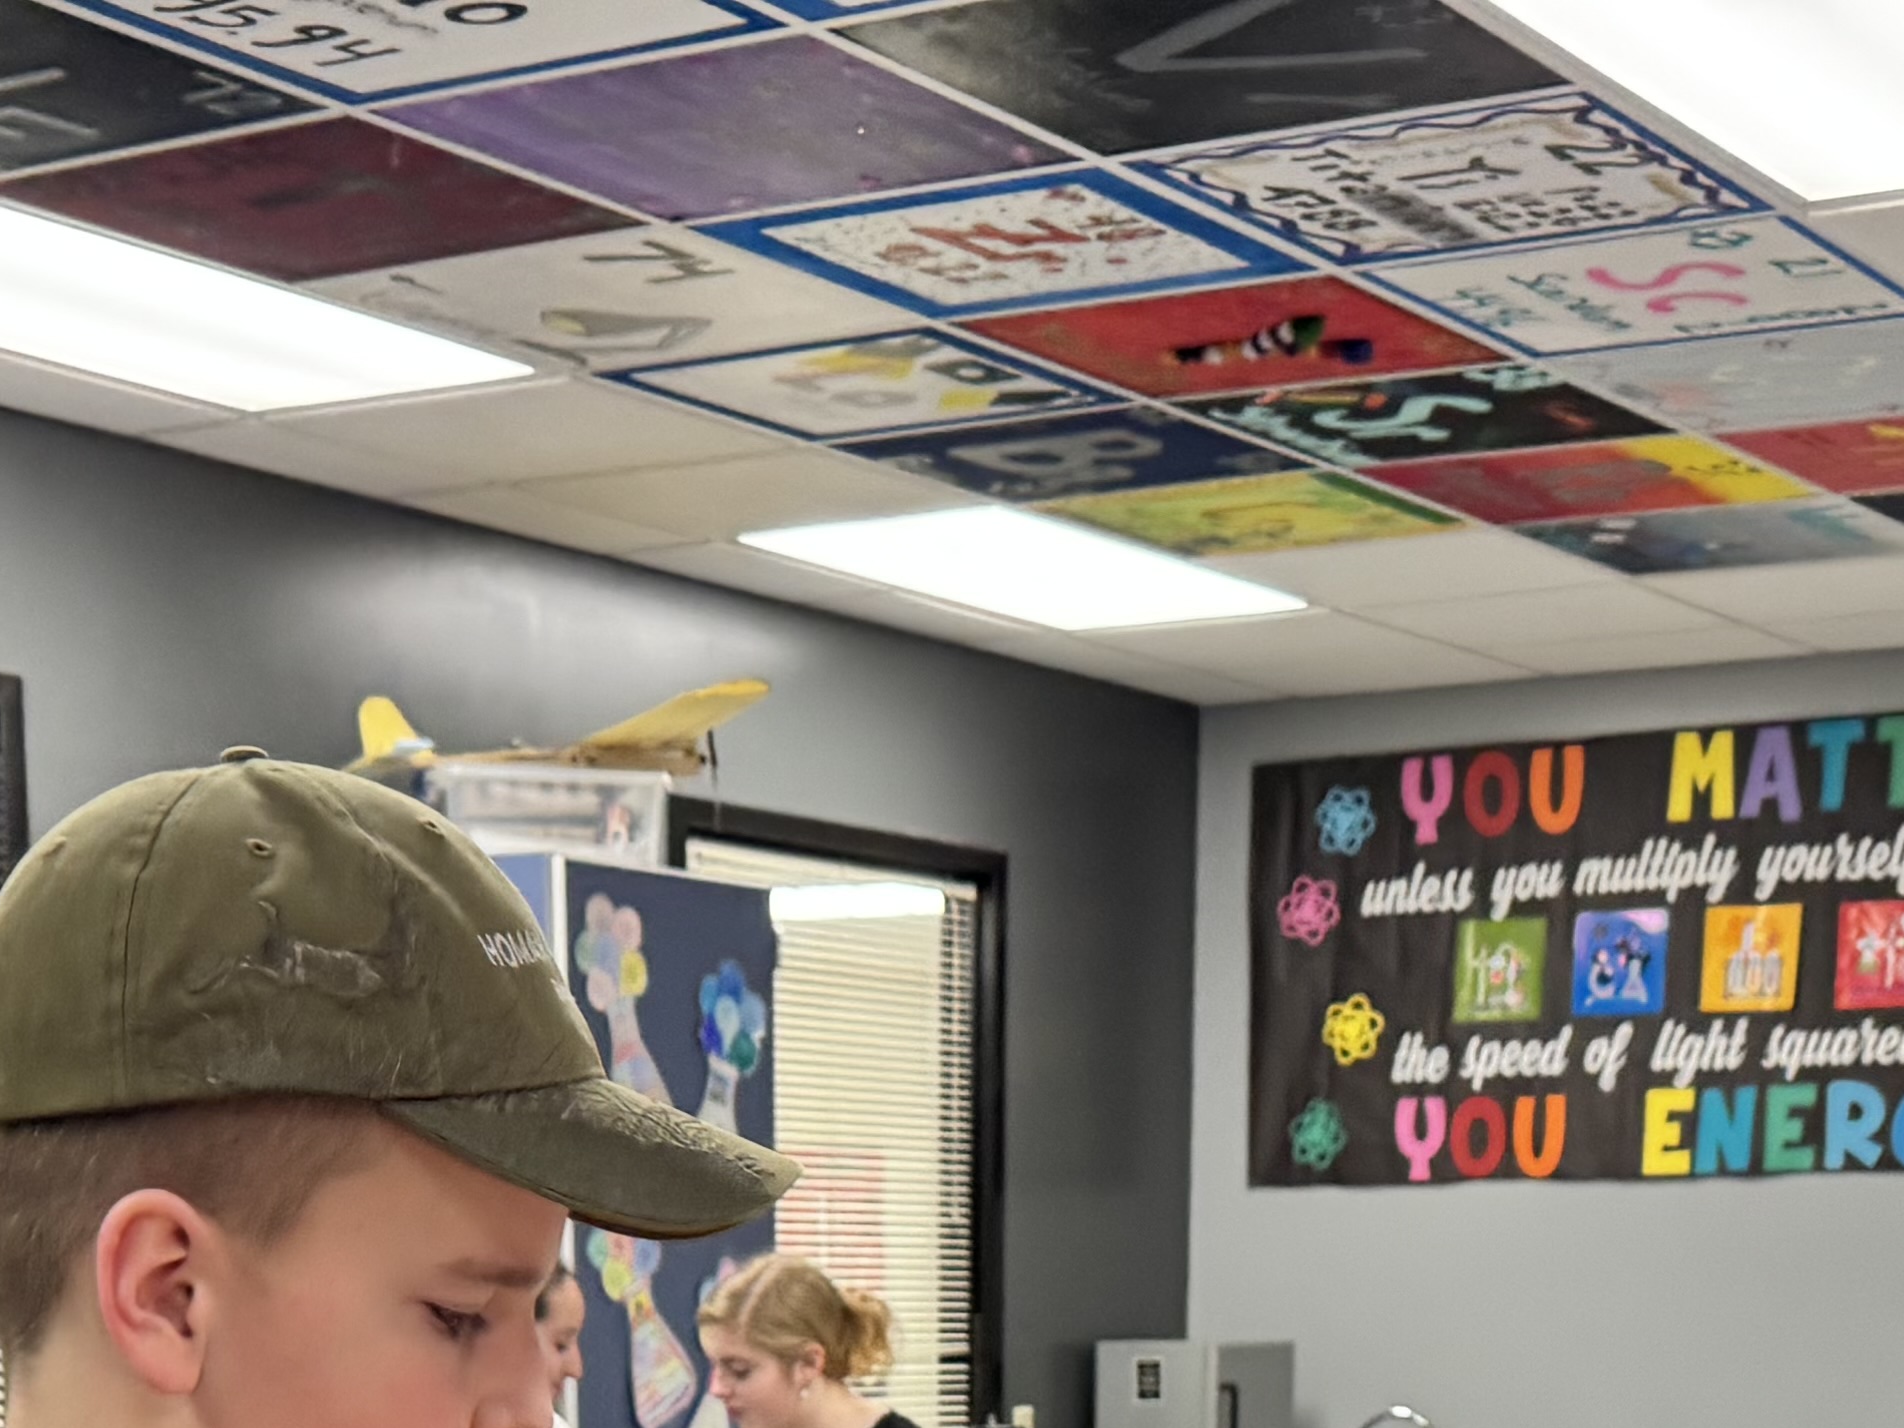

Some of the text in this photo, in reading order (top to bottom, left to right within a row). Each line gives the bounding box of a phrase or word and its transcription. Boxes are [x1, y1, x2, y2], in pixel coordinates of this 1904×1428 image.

[1400, 744, 1585, 845] YOU
[1360, 868, 1474, 919] unless
[1491, 870, 1564, 920] you
[1574, 836, 1739, 902] multiply
[1392, 1030, 1450, 1085] the
[1460, 1024, 1567, 1091] speed
[1583, 1020, 1628, 1092] of
[1650, 1012, 1745, 1085] light
[1394, 1094, 1567, 1182] YOU
